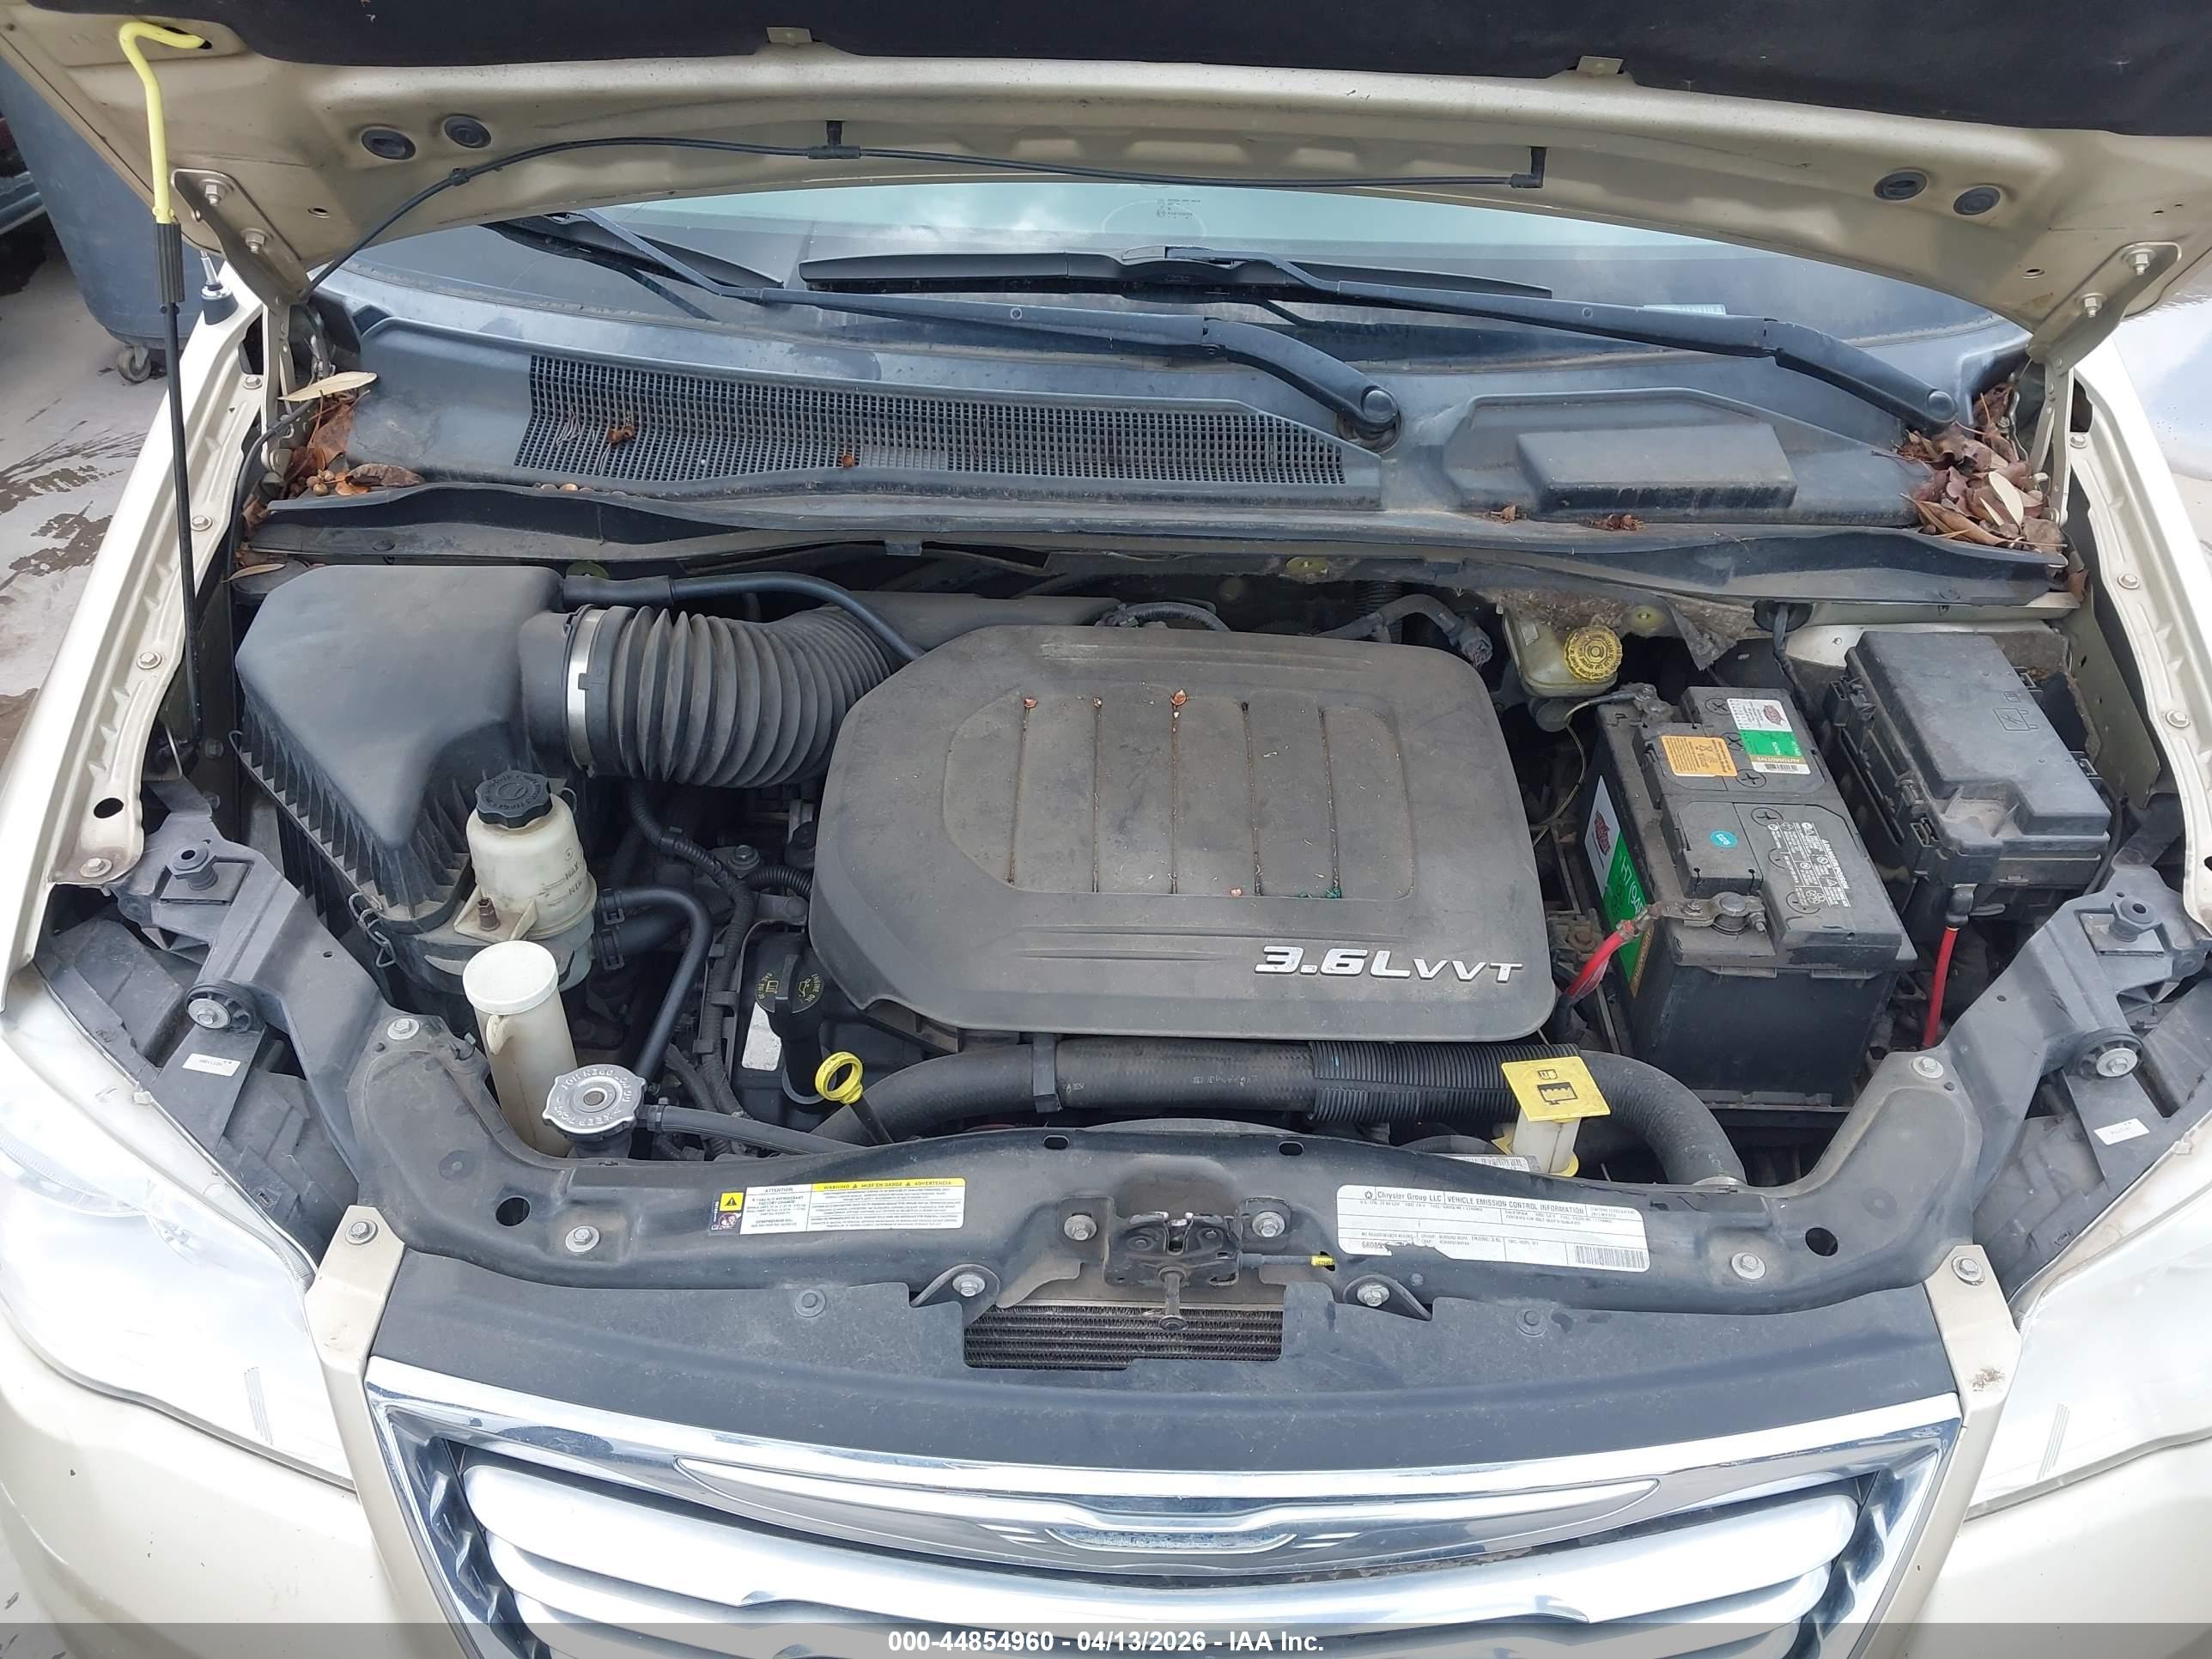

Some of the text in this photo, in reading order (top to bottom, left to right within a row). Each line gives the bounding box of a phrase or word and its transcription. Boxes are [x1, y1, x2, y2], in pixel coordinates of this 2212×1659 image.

[1254, 945, 1524, 982] 3.6L VVT
[805, 973, 822, 1003] ENGINE OIL
[1376, 1190, 1405, 1200] Chrysler
[1407, 1193, 1427, 1202] Group
[1447, 1195, 1474, 1205] VEHICLE
[1475, 1198, 1507, 1207] EMISSION
[1509, 1200, 1538, 1210] CONTROL
[1540, 1205, 1584, 1214] INFORMATION
